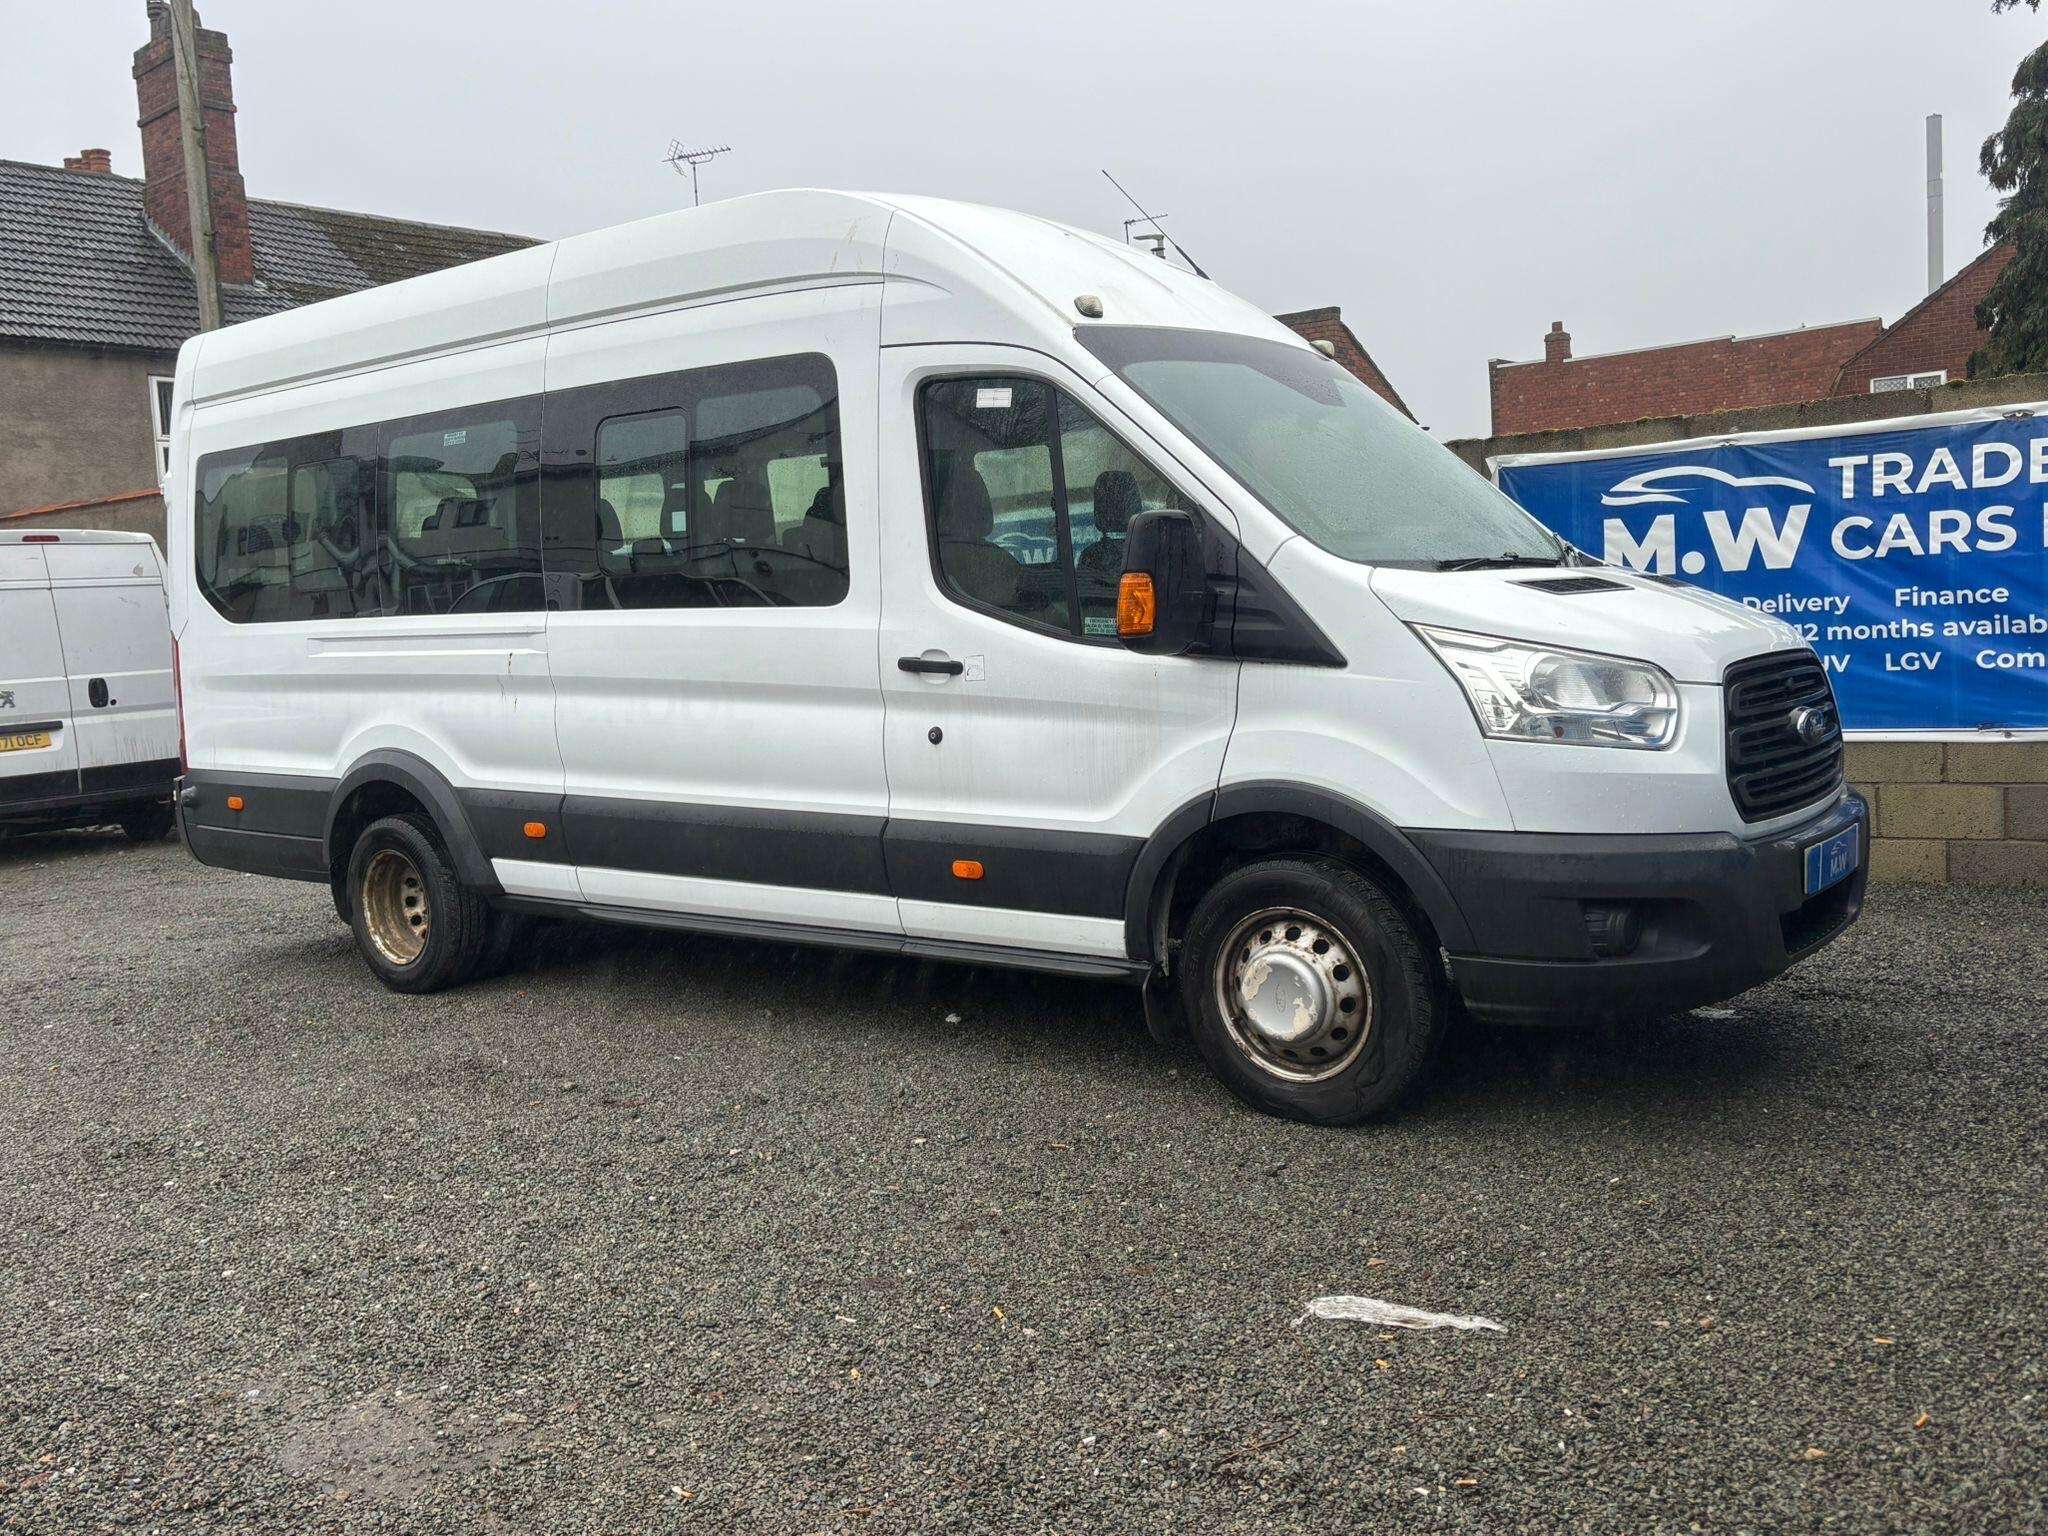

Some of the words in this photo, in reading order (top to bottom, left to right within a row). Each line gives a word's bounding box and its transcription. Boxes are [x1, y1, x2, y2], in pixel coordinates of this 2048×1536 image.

[1828, 437, 2048, 499] TRADE
[1603, 503, 1812, 575] M.W
[1831, 505, 2018, 560] CARS
[1742, 593, 1851, 615] Delivery
[1895, 586, 2009, 608] Finance
[1827, 618, 1935, 640] months
[1943, 614, 2048, 637] availab
[1885, 652, 1942, 671] LGV
[1976, 649, 2046, 669] Com
